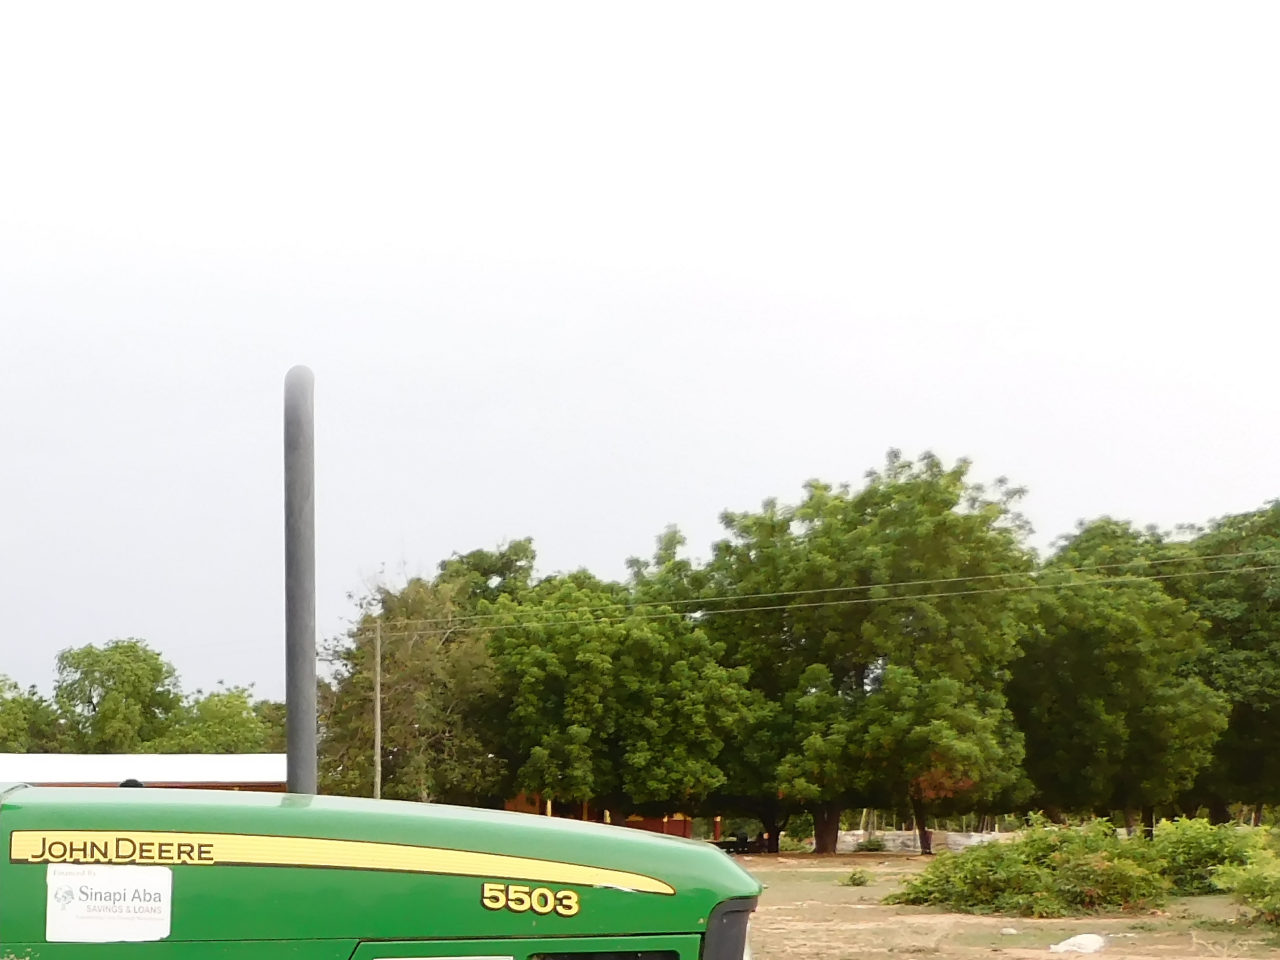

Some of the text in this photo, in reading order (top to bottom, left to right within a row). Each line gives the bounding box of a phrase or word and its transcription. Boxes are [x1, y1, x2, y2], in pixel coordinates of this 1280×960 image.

[31, 837, 214, 861] JOHN DEERE
[78, 885, 162, 905] Sinapi Aba
[481, 882, 580, 917] 5503
[86, 904, 125, 914] SAVINGS
[133, 904, 163, 914] LOANS
